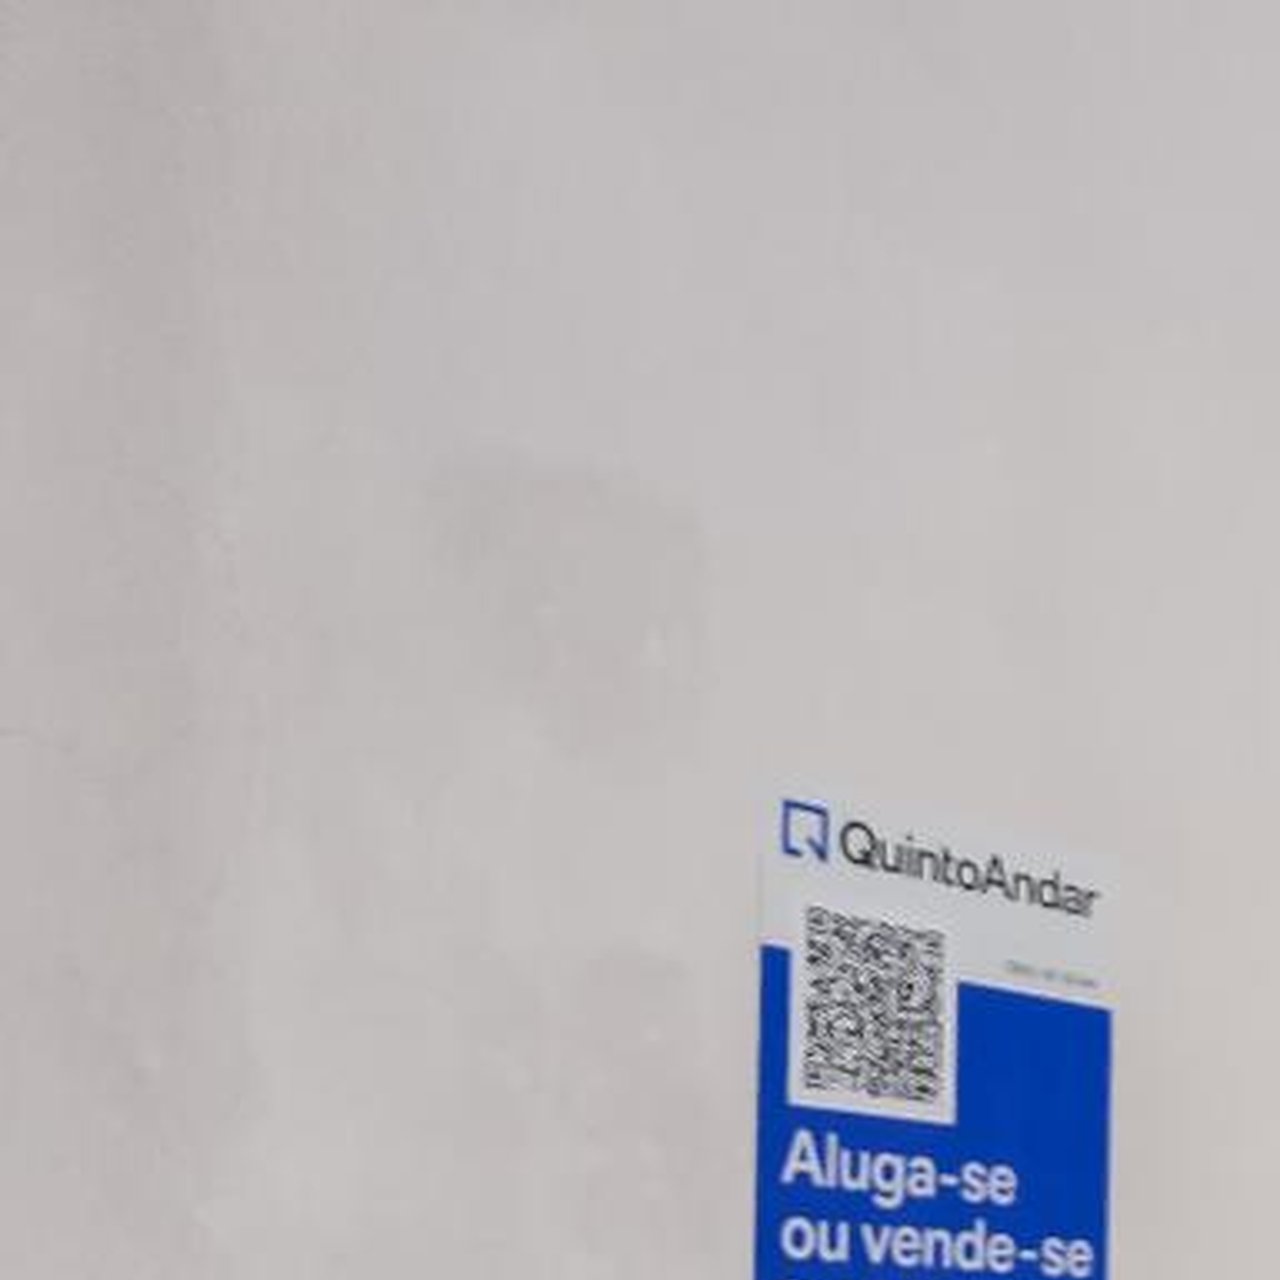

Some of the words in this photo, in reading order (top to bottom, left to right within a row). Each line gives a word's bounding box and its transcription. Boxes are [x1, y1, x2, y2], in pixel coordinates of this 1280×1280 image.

[839, 820, 1098, 917] QuintoAndar
[781, 1130, 1018, 1207] Aluga-se
[781, 1217, 850, 1262] ou
[864, 1219, 1095, 1279] vende-se
